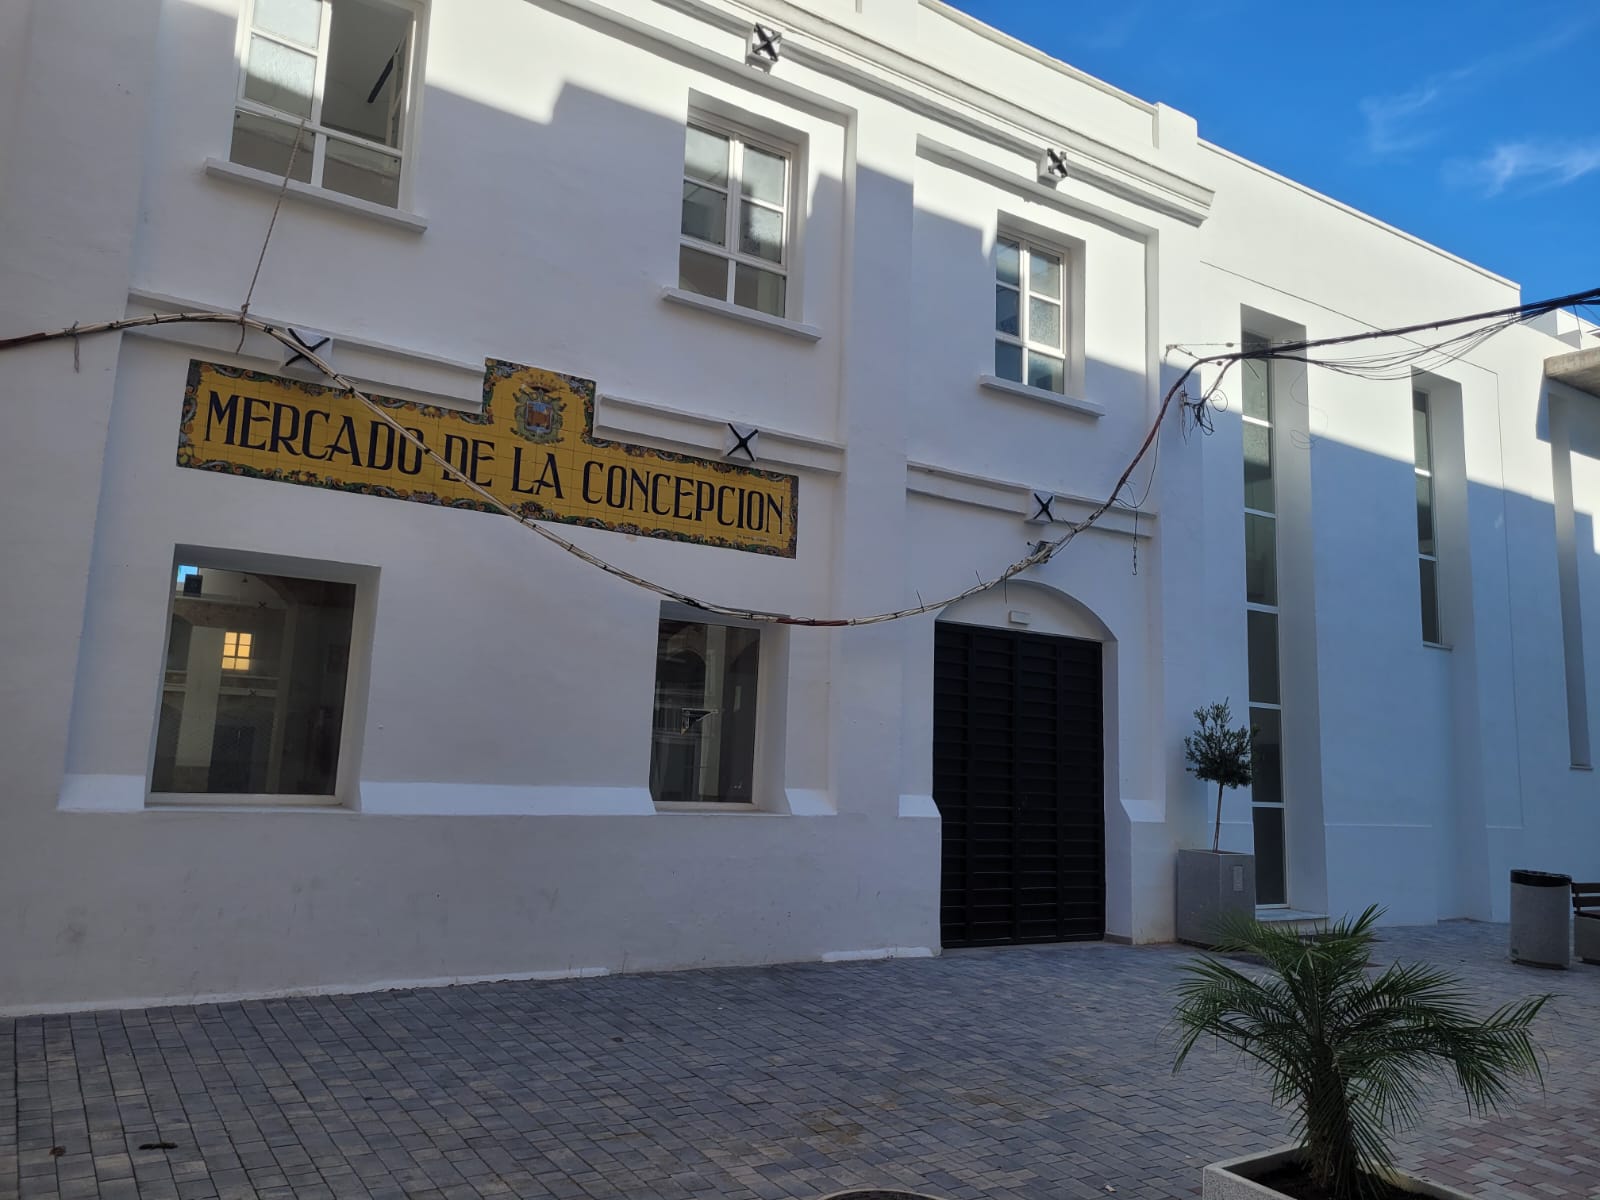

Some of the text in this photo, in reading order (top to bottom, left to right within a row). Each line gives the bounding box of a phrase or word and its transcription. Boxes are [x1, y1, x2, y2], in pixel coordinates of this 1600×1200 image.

[203, 390, 784, 535] MERCADO DE LA CONCEPCION
